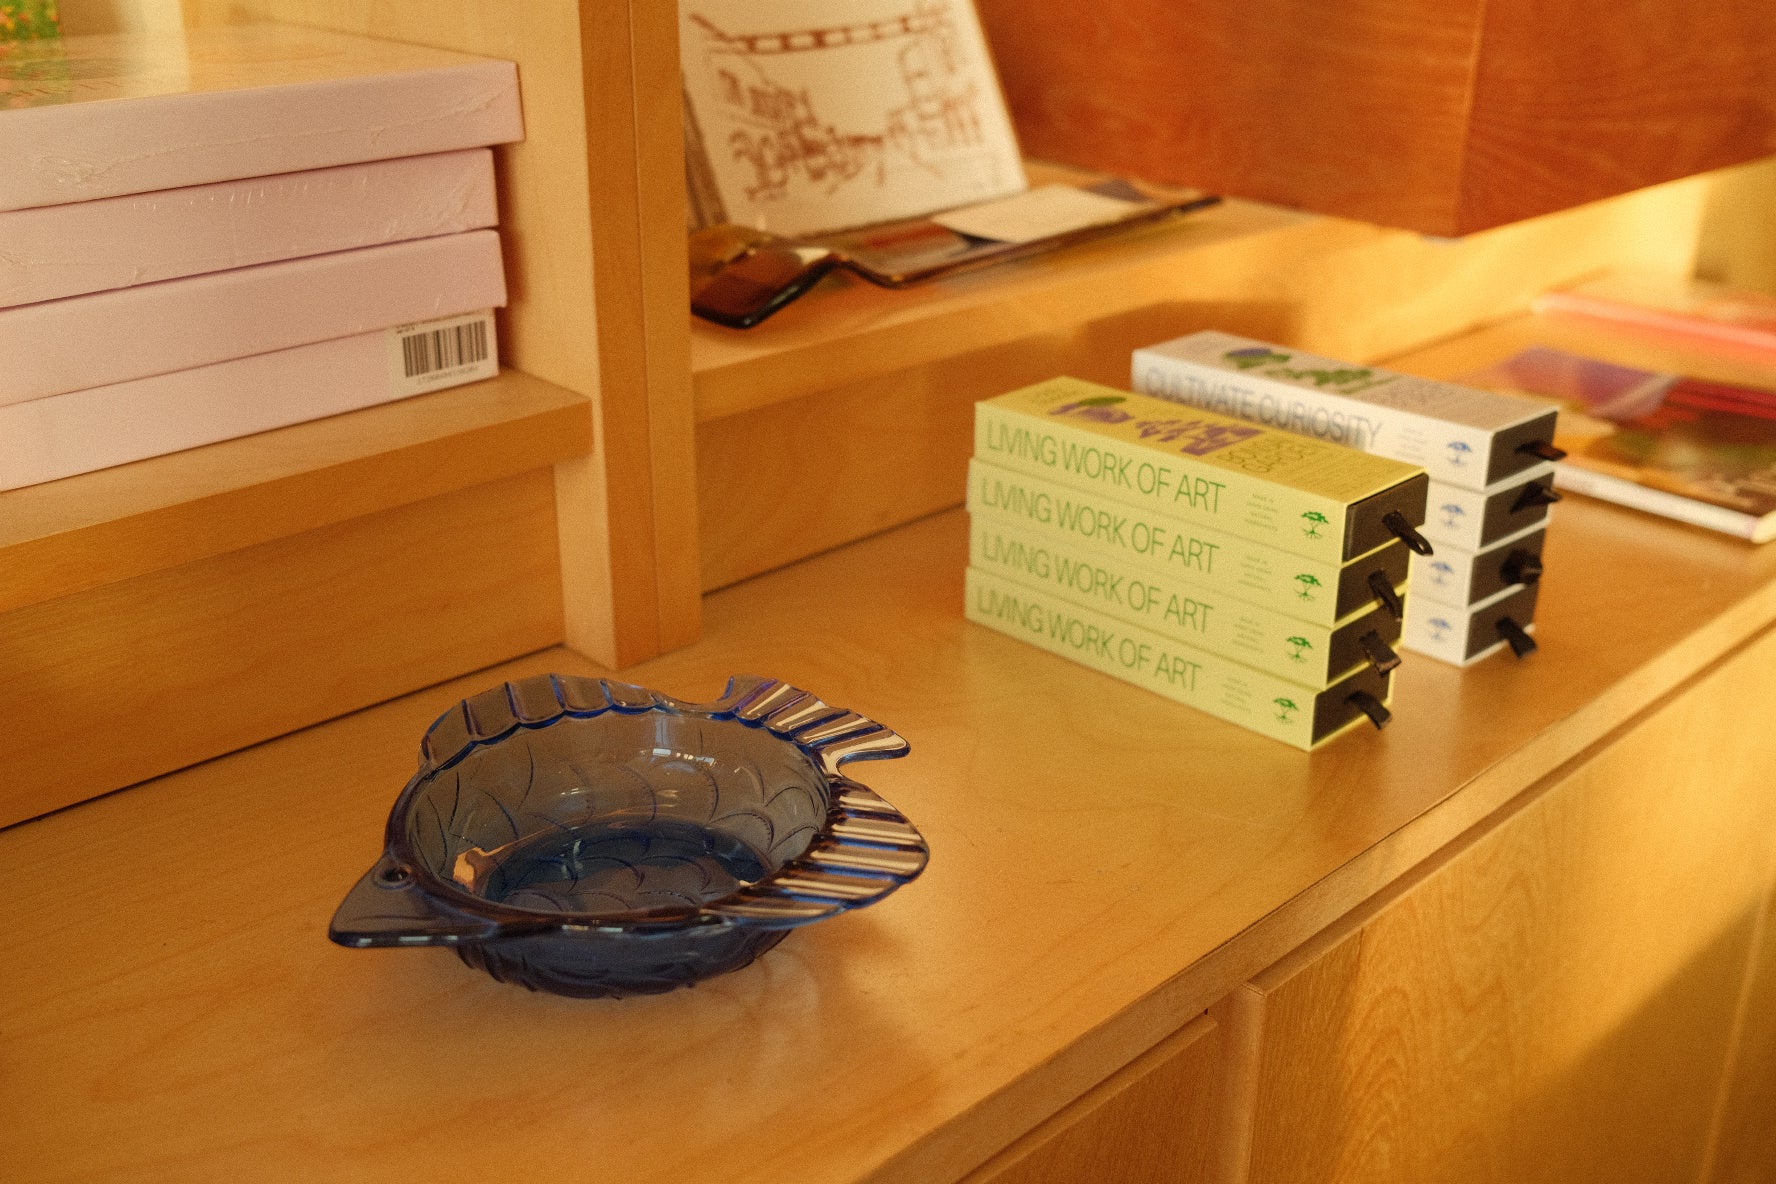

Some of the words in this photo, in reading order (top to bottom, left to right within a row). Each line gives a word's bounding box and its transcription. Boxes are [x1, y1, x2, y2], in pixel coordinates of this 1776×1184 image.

[987, 418, 1057, 467] LIVING
[1061, 440, 1133, 489] WORK
[1137, 462, 1171, 497] OF
[1174, 474, 1227, 514] ART
[982, 477, 1051, 523] LIVING
[1056, 498, 1127, 548] WORK
[1131, 522, 1166, 556] OF
[1168, 534, 1220, 574] ART
[982, 531, 1050, 579] LIVING
[1054, 553, 1124, 604] WORK
[1127, 581, 1161, 614] OF
[1163, 593, 1214, 633] ART
[976, 586, 1044, 634] LIVING
[1049, 611, 1114, 662] WORK
[1118, 638, 1152, 671] OF
[1154, 652, 1202, 692] ART
